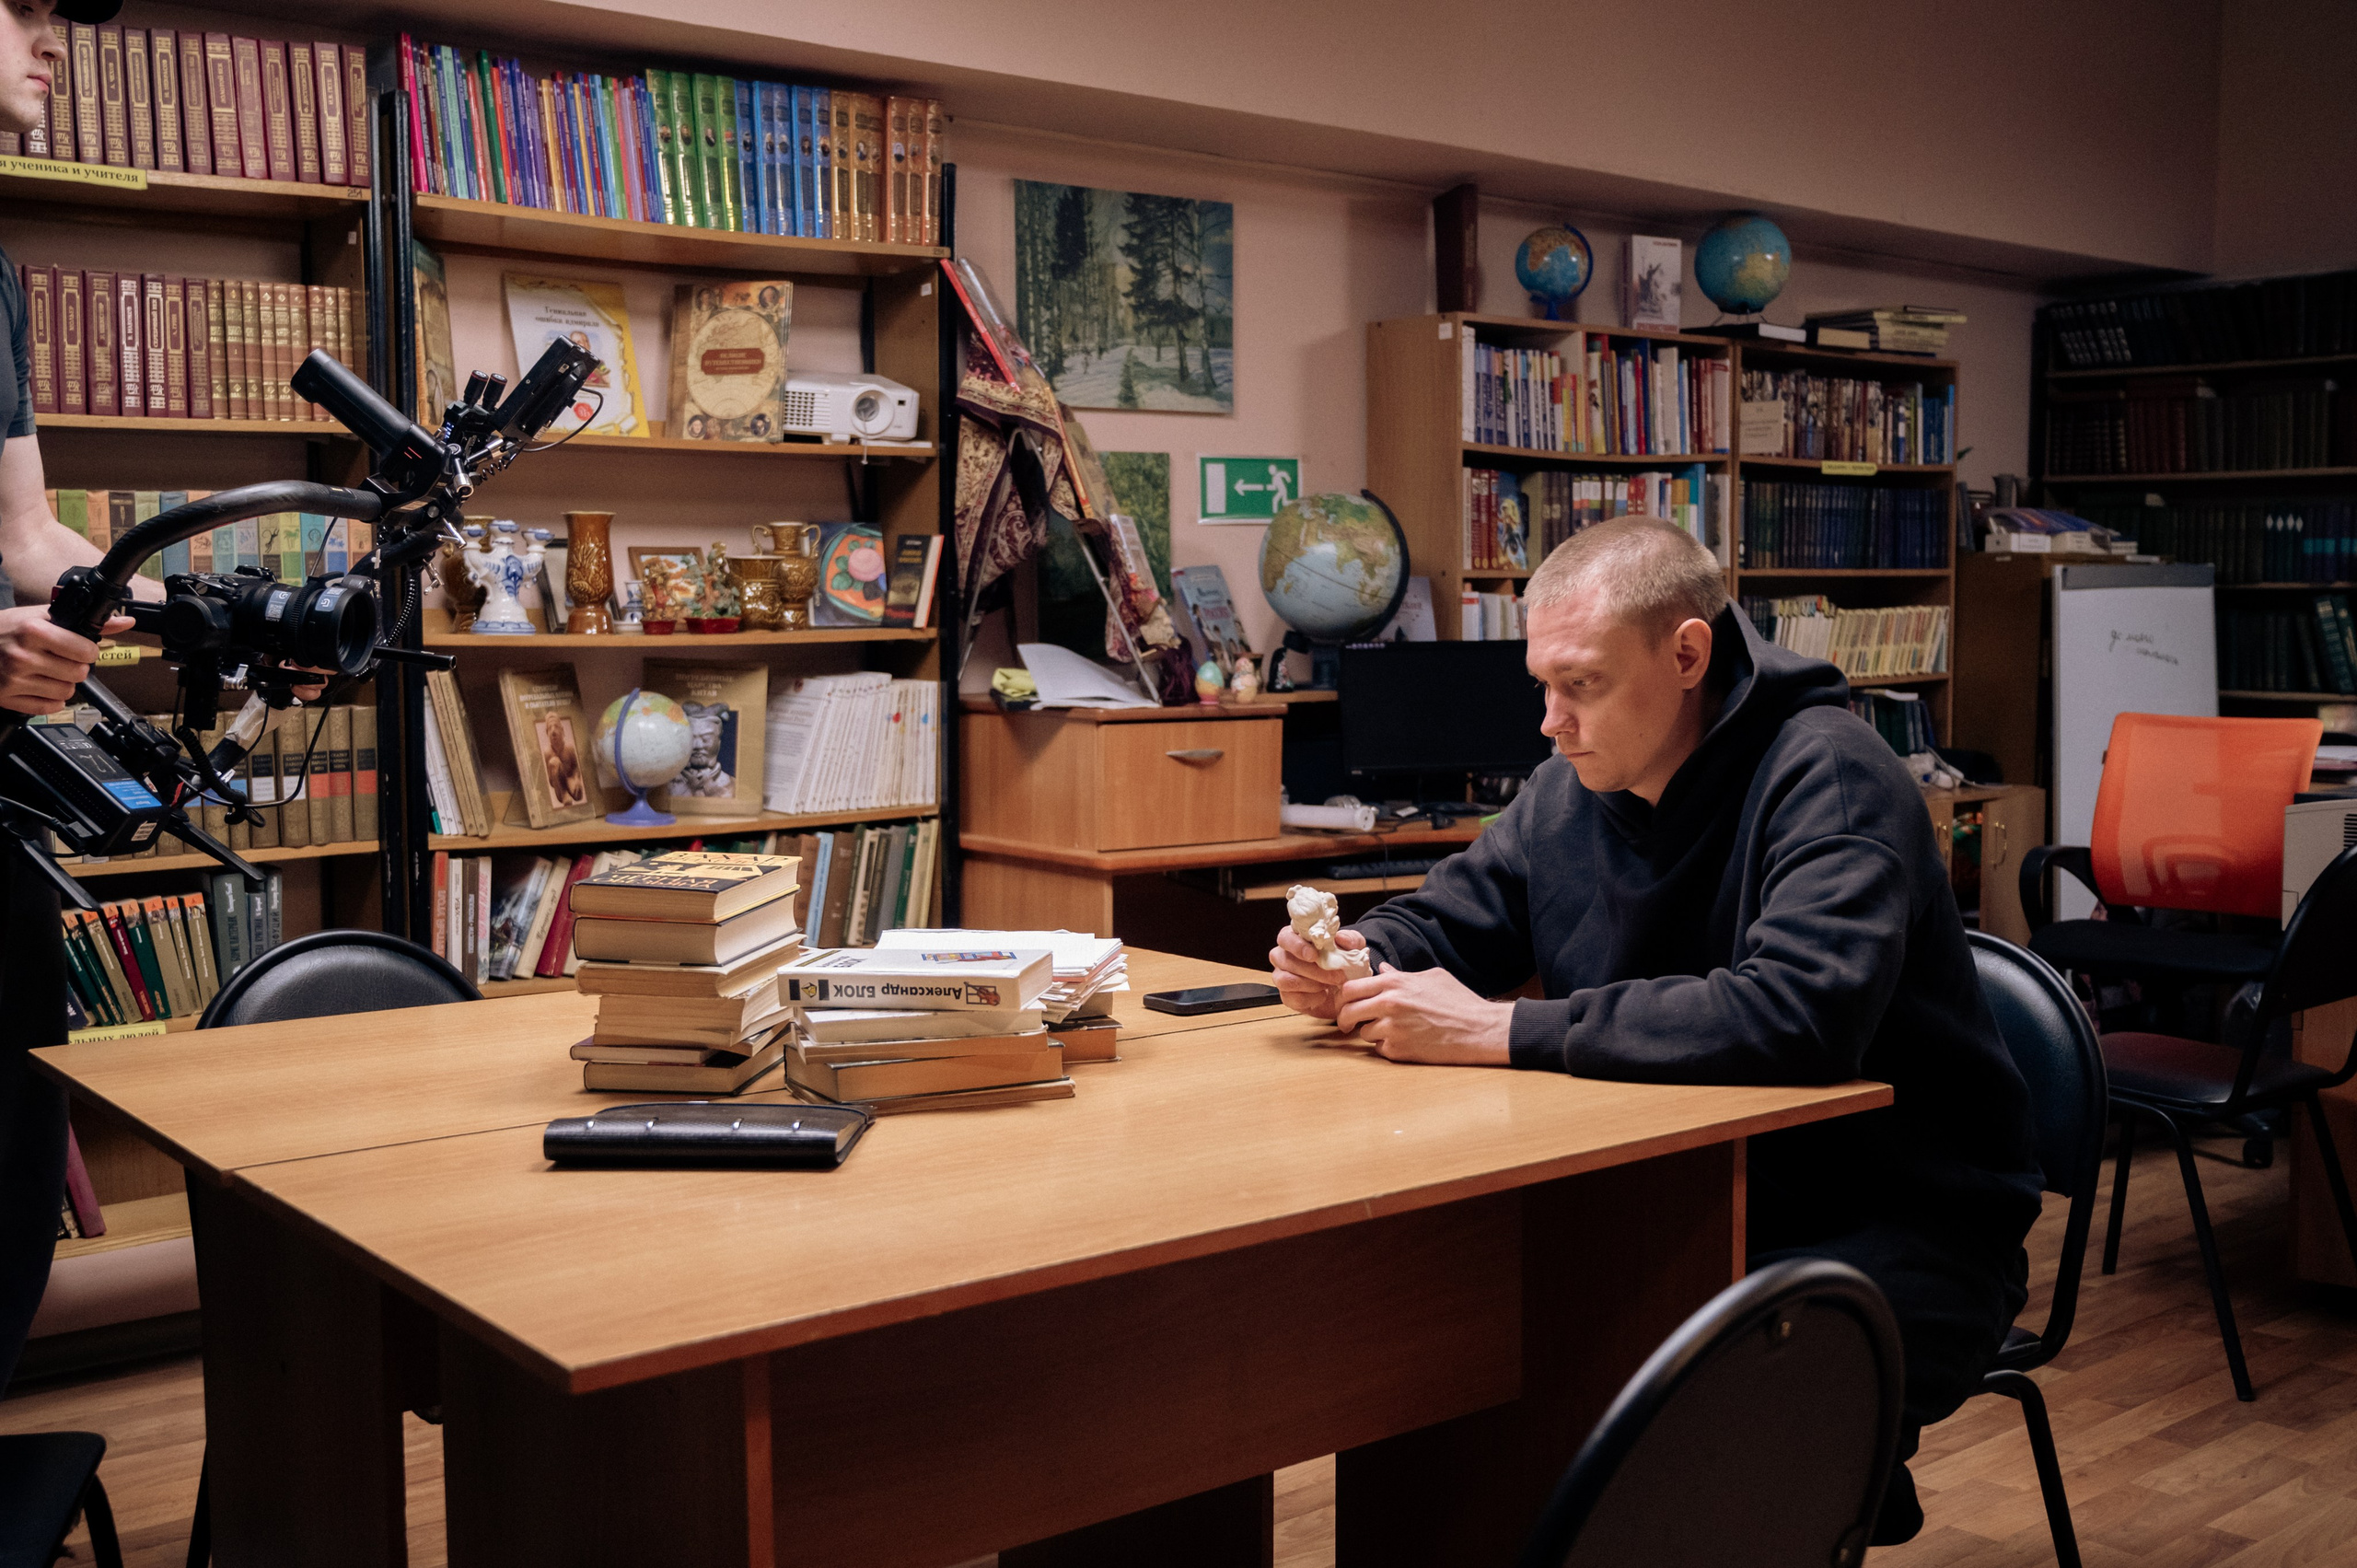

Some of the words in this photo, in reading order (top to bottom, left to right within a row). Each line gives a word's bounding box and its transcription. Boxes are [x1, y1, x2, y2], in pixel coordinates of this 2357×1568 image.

[10, 159, 69, 174] ученика
[84, 168, 138, 183] учителя
[544, 305, 586, 317] Гениальная
[97, 648, 132, 660] етей
[435, 889, 447, 917] УГОЛ
[269, 910, 281, 944] НФУЦИЙ
[833, 984, 876, 998] БЛОК
[881, 982, 963, 1001] Александр
[67, 1035, 114, 1044] льных
